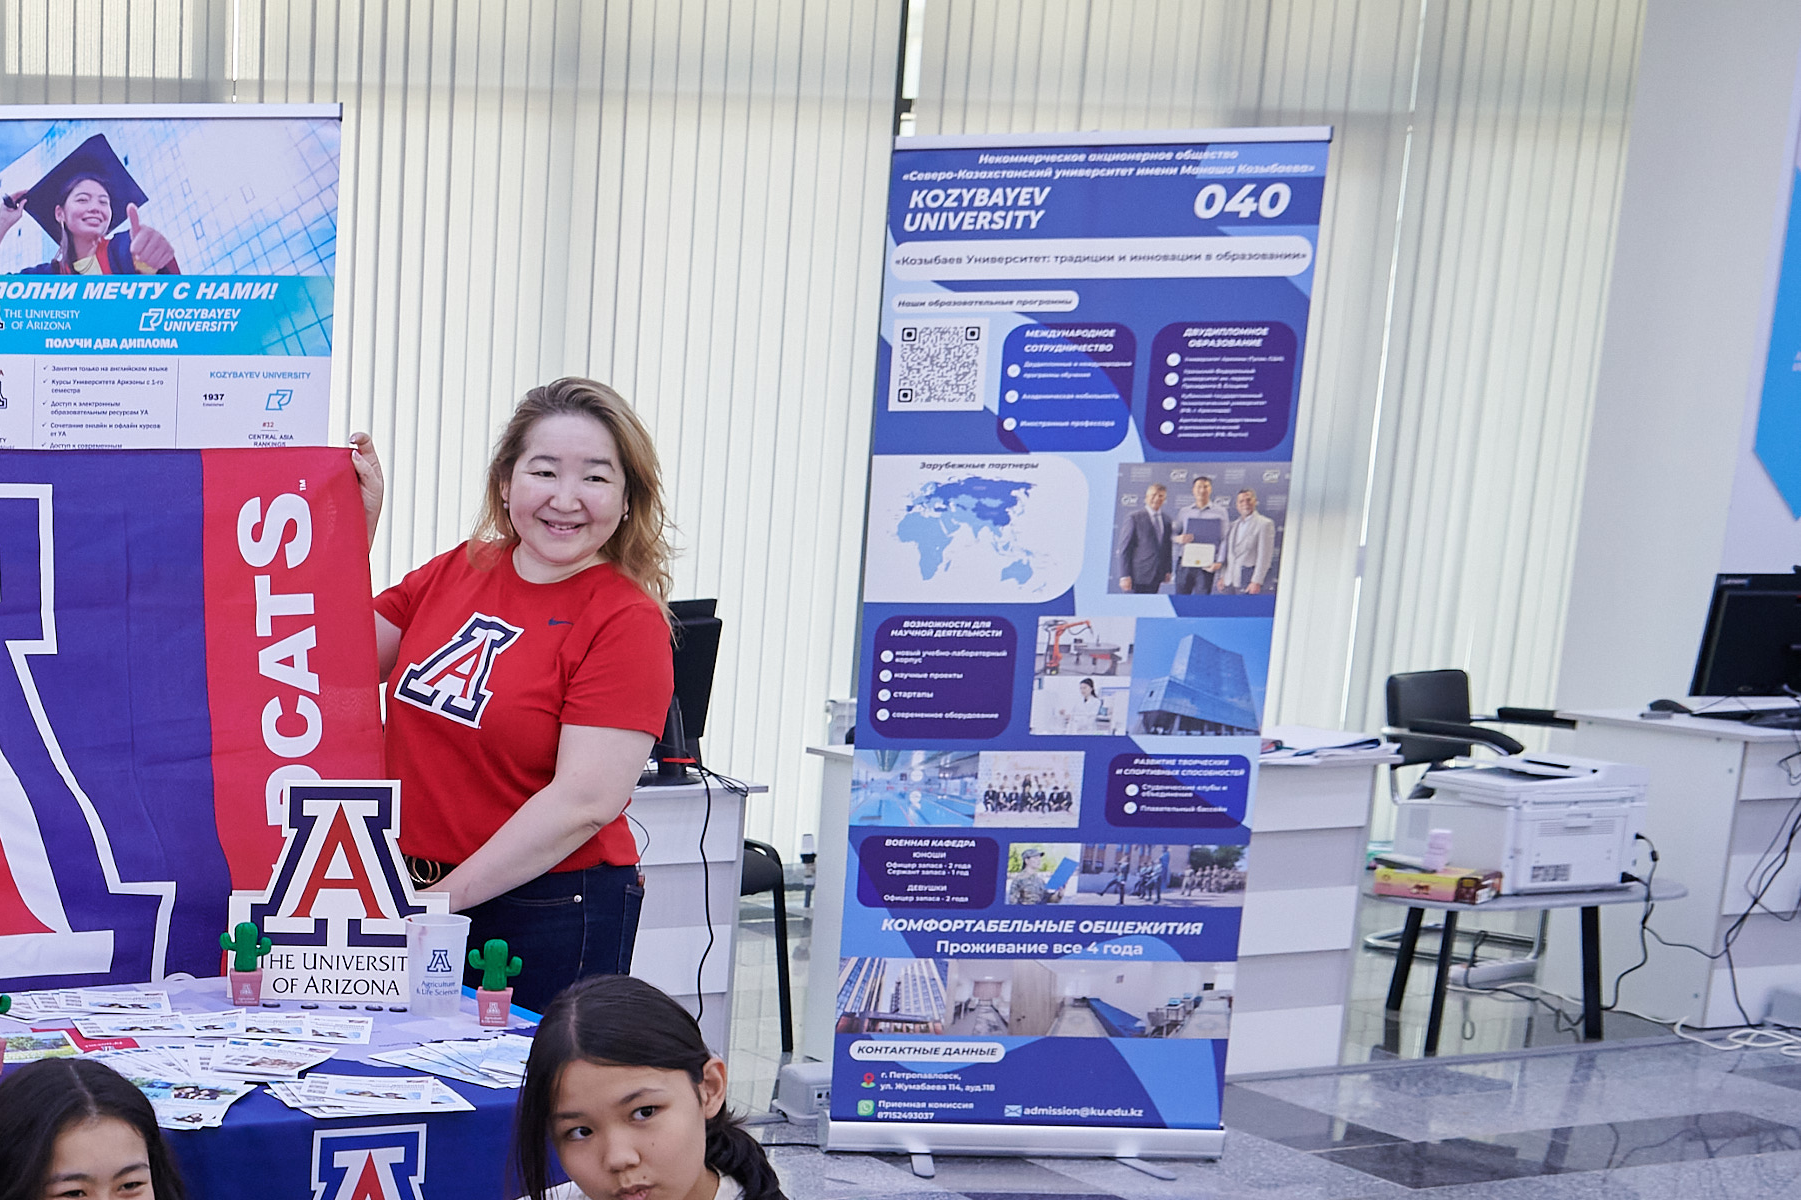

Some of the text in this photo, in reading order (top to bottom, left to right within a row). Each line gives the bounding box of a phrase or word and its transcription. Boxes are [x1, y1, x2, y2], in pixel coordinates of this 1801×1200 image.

[978, 149, 1239, 164] Некоммерческое акционерное общество
[1054, 165, 1136, 180] университет
[1136, 165, 1177, 177] имени
[1179, 164, 1235, 176] Манаша
[909, 186, 1051, 209] KOZYBAYEV
[1193, 182, 1292, 219] 040
[903, 210, 1045, 232] UNIVERSITY
[966, 254, 1050, 265] Университет:
[1054, 254, 1114, 264] традиции
[1130, 254, 1201, 263] инновации
[82, 282, 169, 300] МЕЧТУ
[173, 282, 191, 300] С
[196, 282, 279, 300] НАМИ!
[898, 298, 1073, 308] Наши образовательные программы
[3, 308, 81, 321] THE UNIVERSITY
[165, 308, 241, 321] KOZYBAYEV
[11, 319, 72, 332] OF ARIZONA
[163, 320, 239, 333] UNIVERSITY
[1025, 329, 1116, 338] МЕЖДУНАРОДНОЕ
[45, 338, 178, 351] ПОЛУЧИ ДВА ДИПЛОМА
[1024, 344, 1113, 353] СОТРУДНИЧЕСТВО
[210, 371, 311, 380] KOZYBAYEV UNIVERSITY
[919, 461, 1039, 471] Зарубежные партнеры
[891, 629, 933, 637] НАУЧНОЙ
[394, 612, 525, 729] A
[885, 839, 976, 848] ВОЕННАЯ КАФЕДРА
[251, 786, 427, 948] A
[881, 918, 1204, 936] КОМФОРТАБЕЛЬНЫЕ ОБЩЕЖИТИЯ
[936, 940, 1143, 956] Проживание все 4 года
[303, 953, 408, 972] UNIVERSIT
[427, 949, 452, 972] A
[273, 975, 400, 996] OF ARIZONA
[421, 981, 455, 989] Agriculture
[422, 988, 432, 996] Life
[857, 1045, 998, 1057] КОНТАКТНЫЕ ДАННЫЕ
[894, 1082, 947, 1092] Жумабаева
[878, 1100, 974, 1110] Приемная комиссия
[1023, 1106, 1144, 1118] admission@ku.edu.kz
